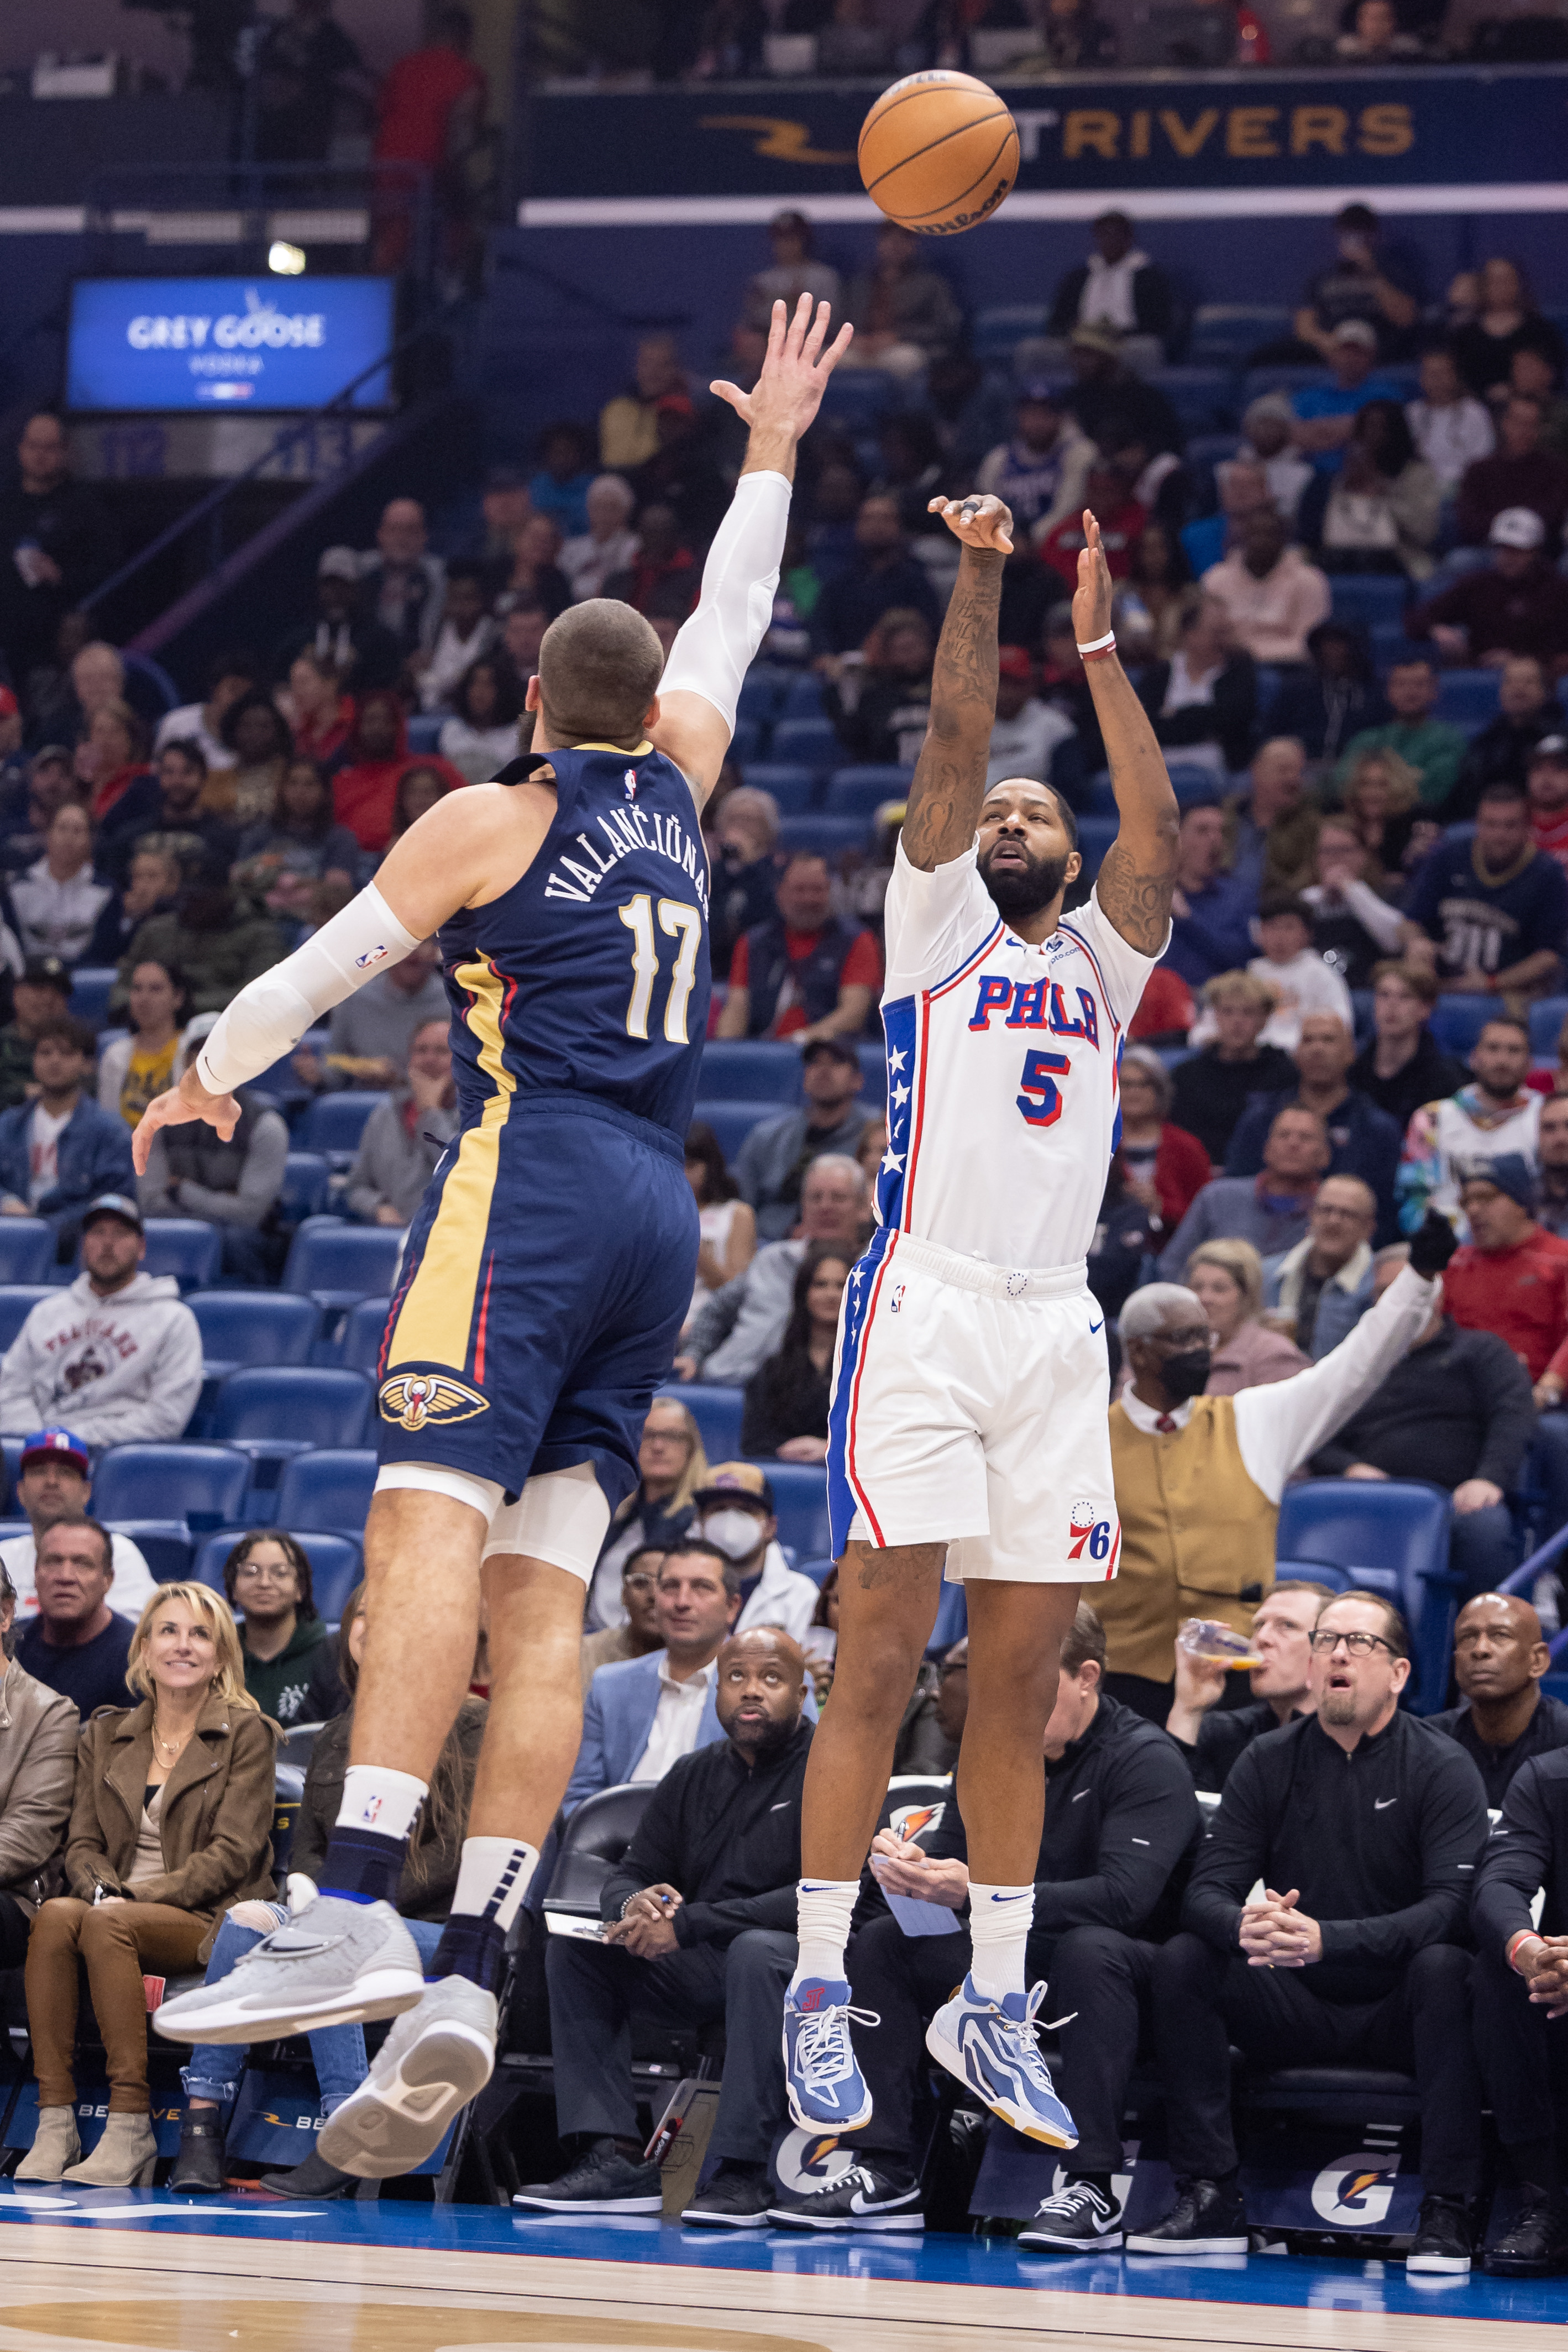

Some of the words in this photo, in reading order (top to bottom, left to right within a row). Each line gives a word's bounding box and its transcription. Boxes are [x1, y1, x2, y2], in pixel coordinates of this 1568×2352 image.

[127, 314, 211, 350] GREY
[214, 312, 325, 349] GOOSE
[618, 894, 701, 1044] 17
[1016, 1049, 1071, 1127] 5
[1067, 1521, 1110, 1560] 76
[803, 1987, 825, 2011] JT
